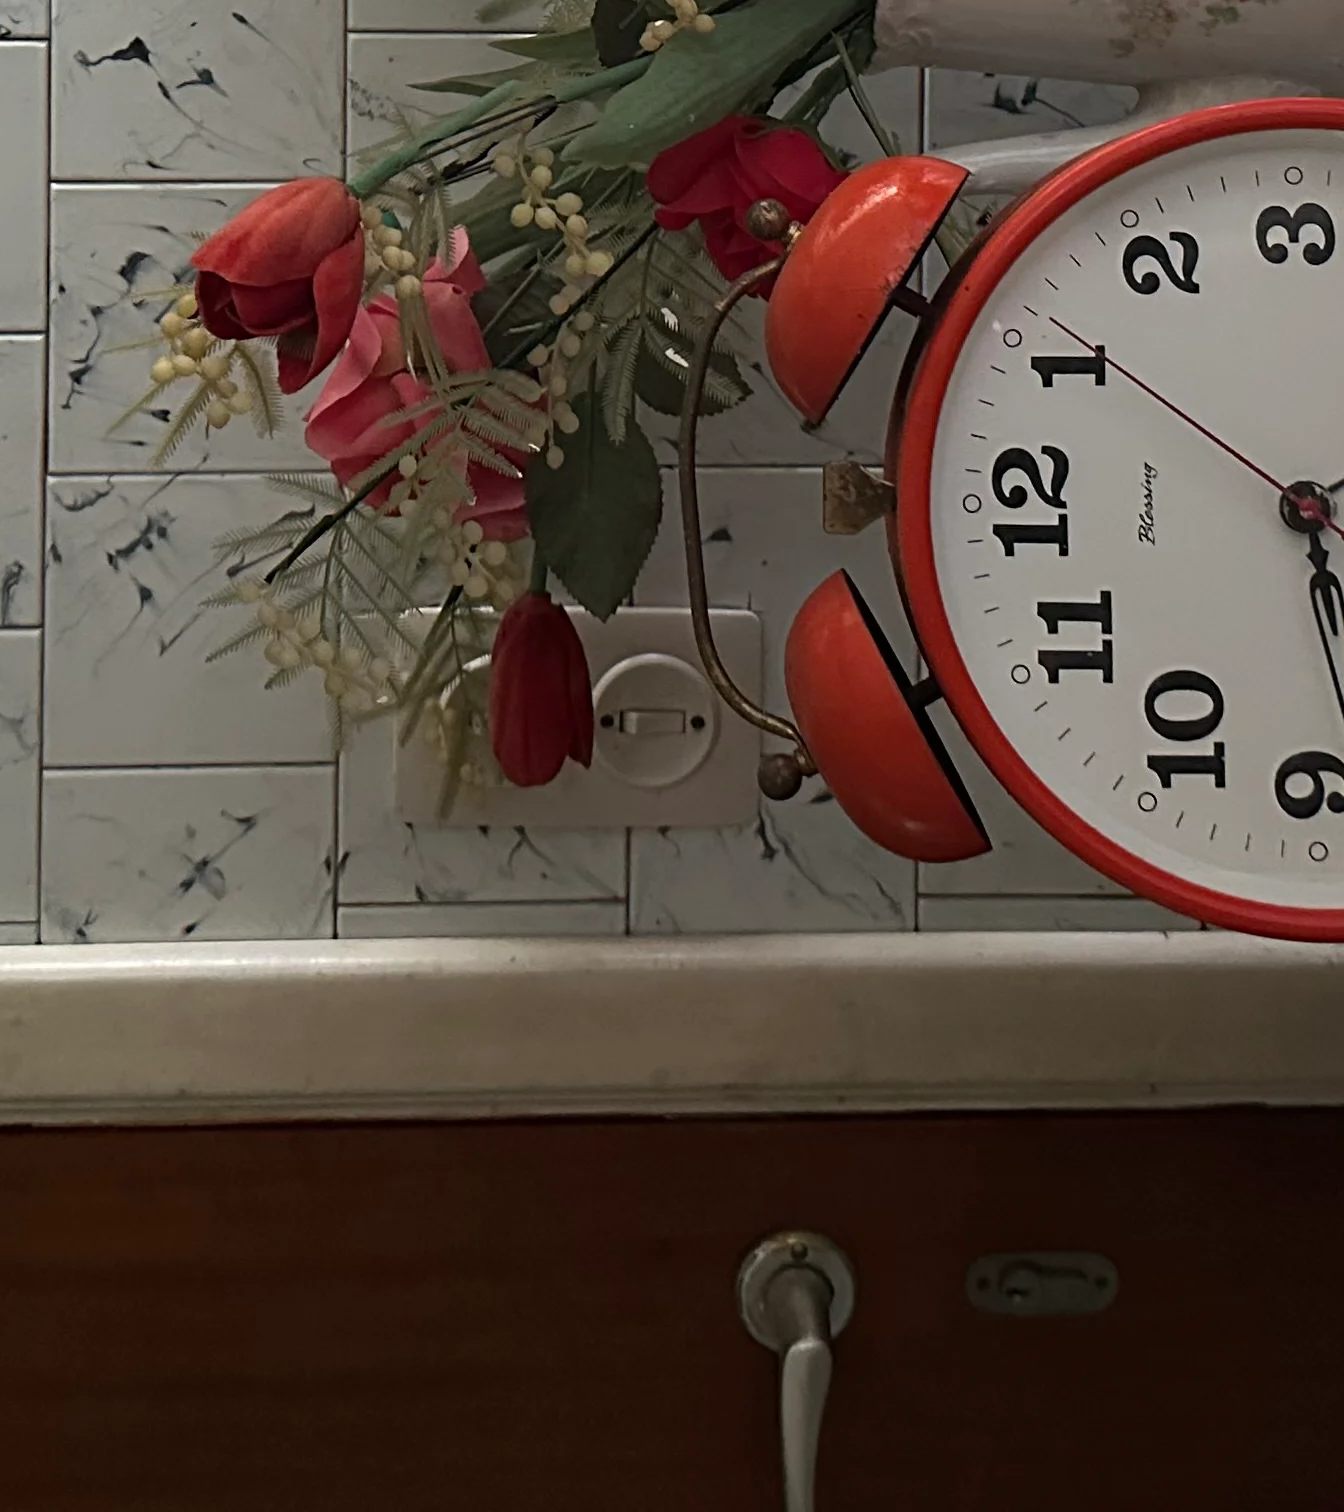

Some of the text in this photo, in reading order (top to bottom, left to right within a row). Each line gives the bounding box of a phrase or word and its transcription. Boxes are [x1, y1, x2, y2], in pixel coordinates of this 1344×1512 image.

[1122, 231, 1200, 296] 2
[1255, 202, 1336, 266] 3
[1030, 344, 1107, 386] 1
[991, 445, 1070, 557] 12
[1138, 461, 1158, 546] Blessing
[1036, 590, 1113, 684] 11
[1144, 669, 1226, 789] 10
